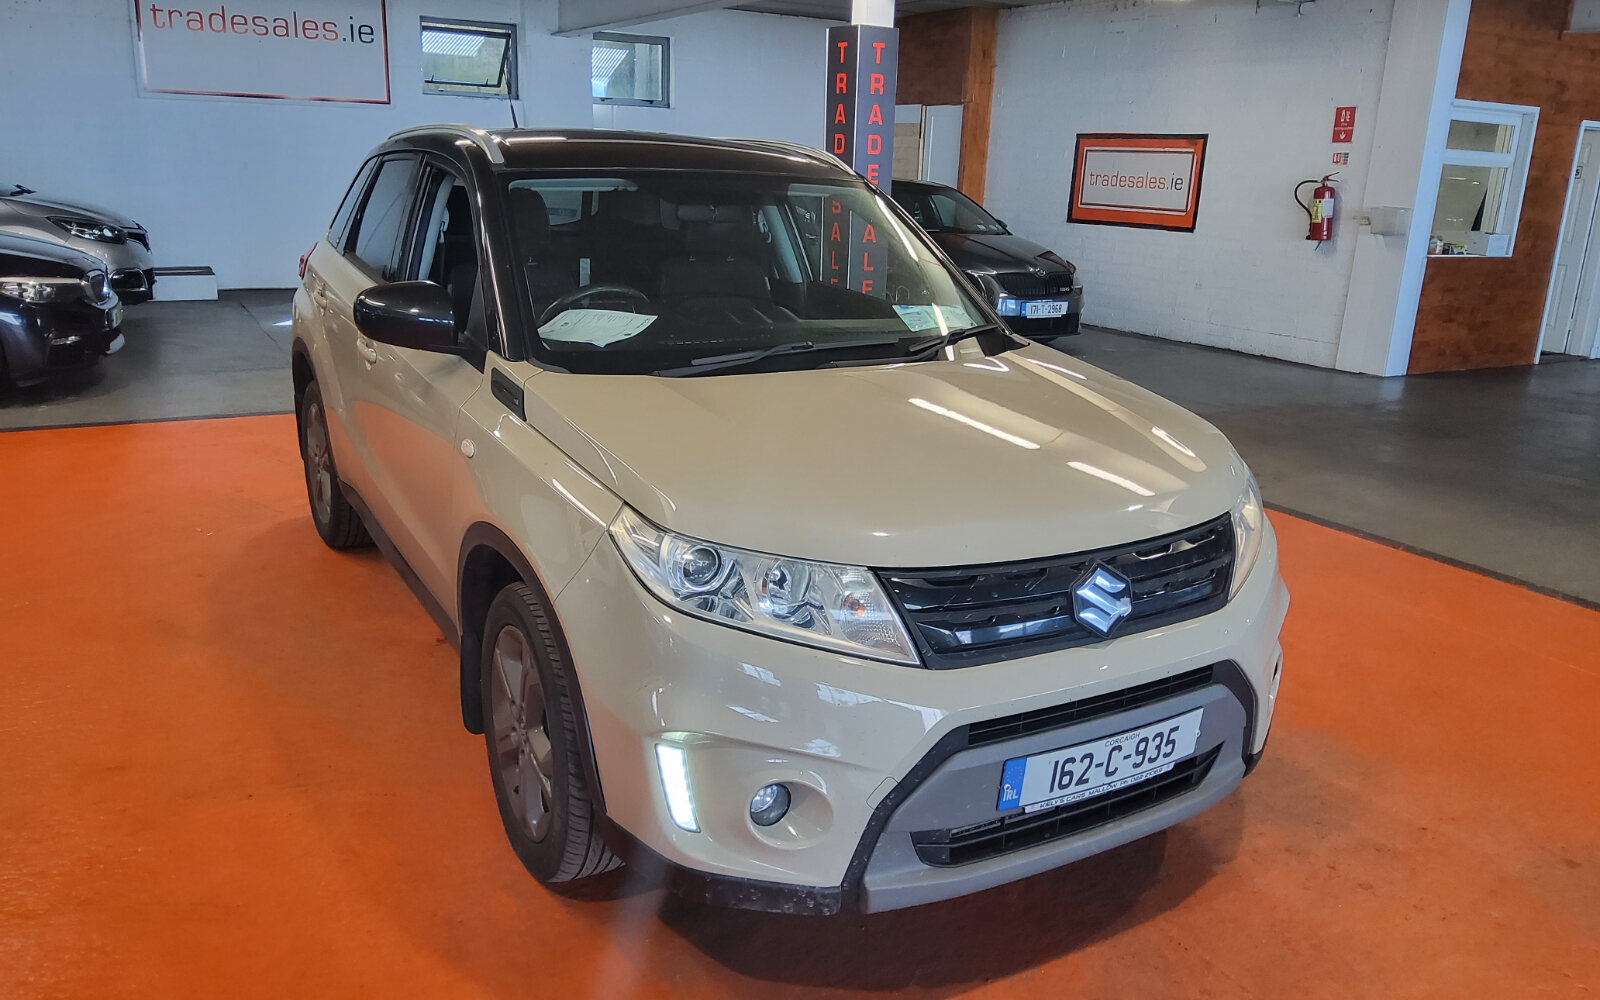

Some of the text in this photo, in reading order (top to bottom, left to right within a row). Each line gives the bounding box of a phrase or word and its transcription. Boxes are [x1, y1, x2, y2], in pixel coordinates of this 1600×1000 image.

[149, 3, 375, 44] tradesales.ie
[833, 41, 848, 155] TRAD
[1089, 170, 1184, 191] tradesales.ie
[1030, 304, 1063, 315] 171-T-2968
[1104, 731, 1141, 748] CORCAIGH
[1049, 725, 1180, 793] 162-C-935
[1003, 788, 1019, 802] IRL
[1088, 783, 1118, 796] MALLOW
